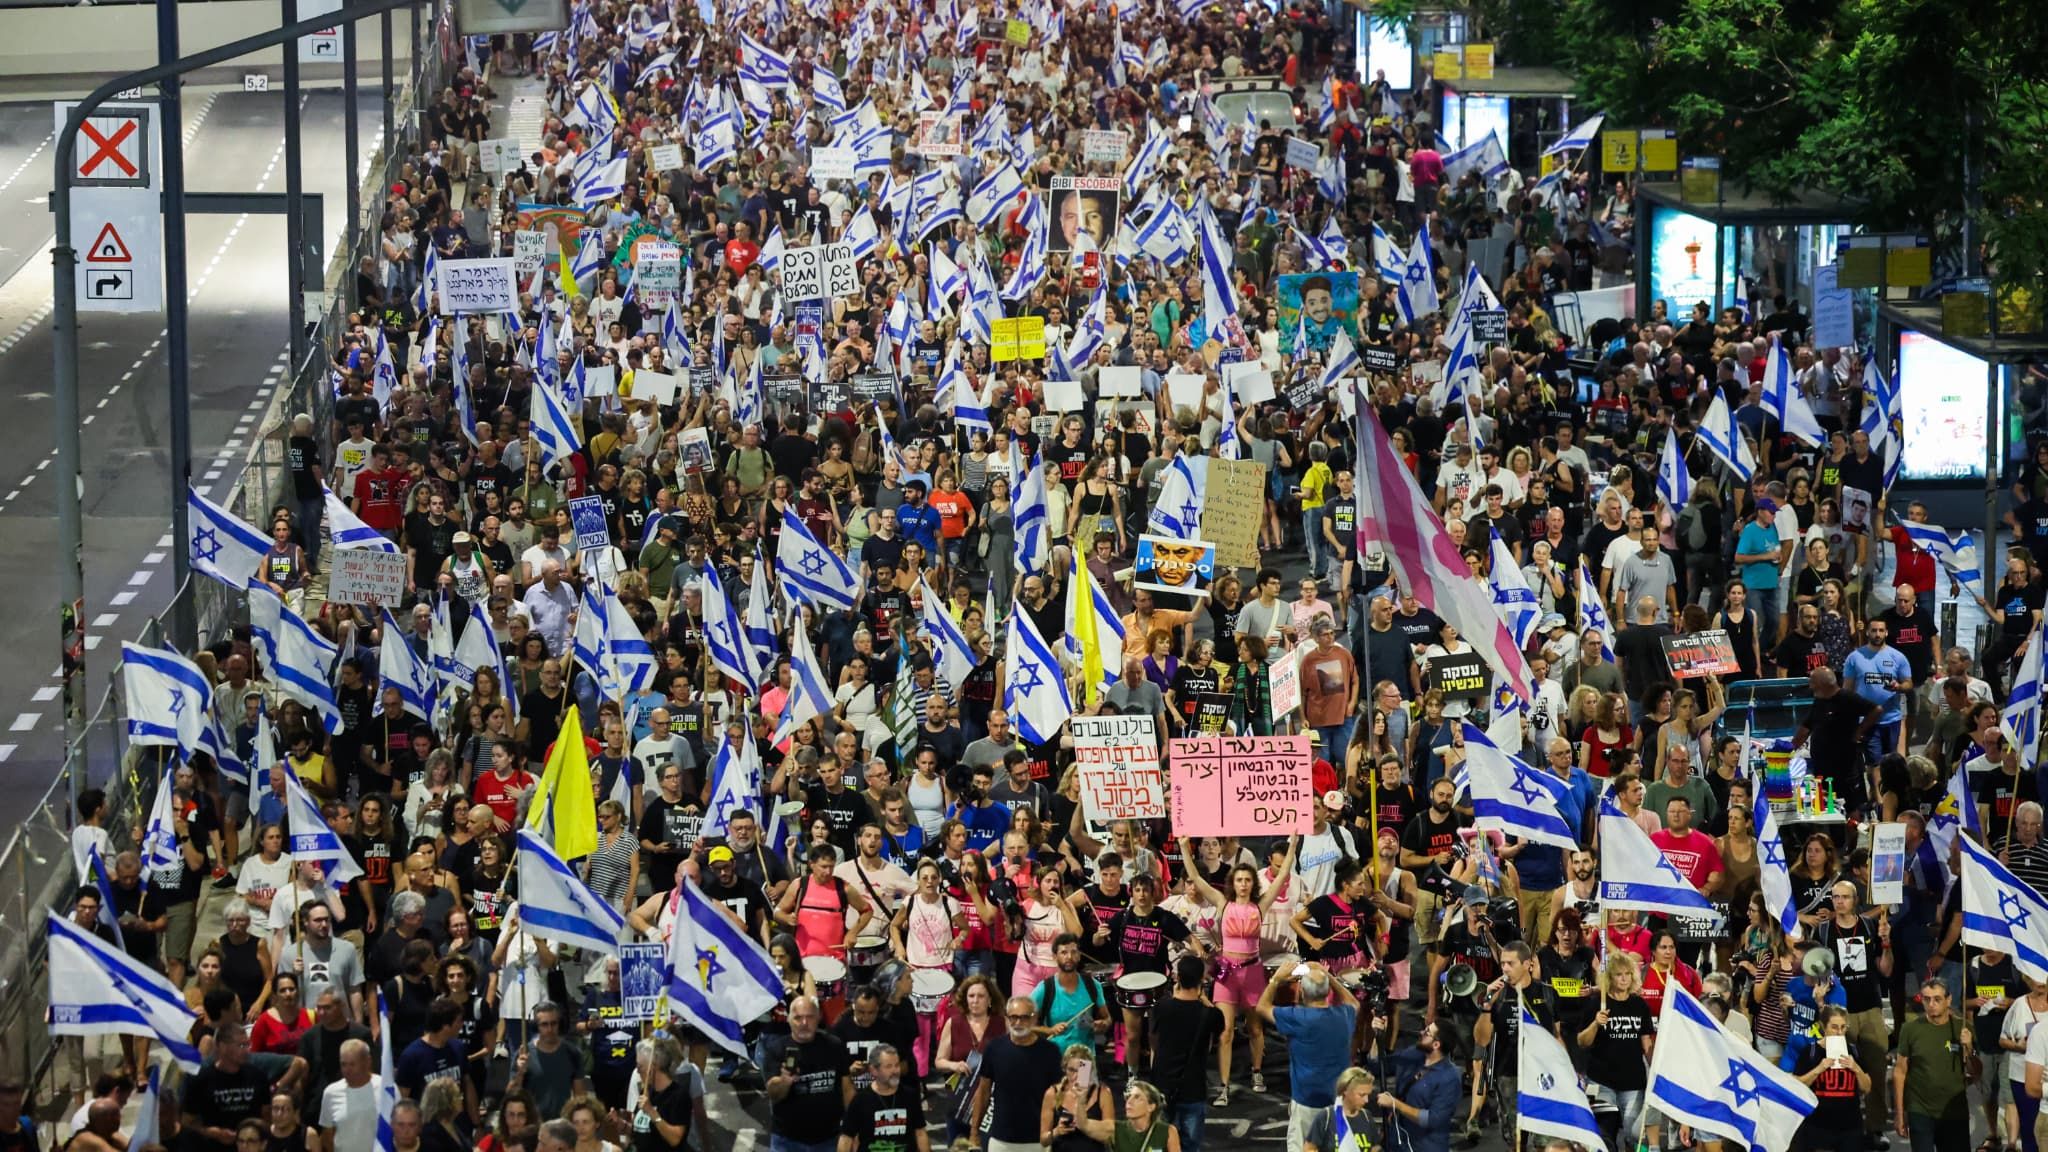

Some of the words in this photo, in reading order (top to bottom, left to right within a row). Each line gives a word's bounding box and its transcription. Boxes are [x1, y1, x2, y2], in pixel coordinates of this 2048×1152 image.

[247, 78, 267, 89] 5.2
[1051, 177, 1072, 189] BIBI
[1073, 178, 1120, 190] ESCOBAR
[784, 267, 817, 288] מתים
[830, 263, 852, 281] גם
[784, 283, 819, 301] סובלים
[831, 278, 856, 296] וגם
[820, 384, 840, 394] חיים
[817, 400, 838, 411] Life
[476, 479, 496, 489] FCK
[572, 498, 602, 511] בחירות
[579, 532, 606, 547] עכשיו
[1402, 625, 1430, 634] Wharton
[1672, 638, 1702, 648] שבויים
[1442, 663, 1480, 680] עסקה
[1441, 676, 1484, 692] עכשיו!
[1203, 703, 1227, 715] עסקה
[1115, 716, 1154, 737] כולנו
[1104, 736, 1122, 747] 62
[1225, 739, 1256, 755] נגד
[1112, 745, 1158, 763] עבדים
[1174, 742, 1216, 755] בעד
[1112, 760, 1127, 771] של
[1228, 760, 1274, 778] הבטחון
[1277, 759, 1297, 771] שר
[1130, 769, 1161, 788] רודן
[1247, 774, 1299, 790] הבטחון
[1093, 787, 1151, 811] מסוכן
[823, 809, 855, 823] שבע
[1142, 804, 1164, 817] ולא
[682, 834, 698, 842] STO
[1431, 833, 1454, 847] כולנו
[682, 841, 694, 849] TH
[1689, 922, 1713, 931] STOP
[1689, 929, 1708, 938] THE
[1708, 929, 1730, 938] WAR
[621, 946, 663, 960] בחירות
[626, 998, 657, 1015] כשיו
